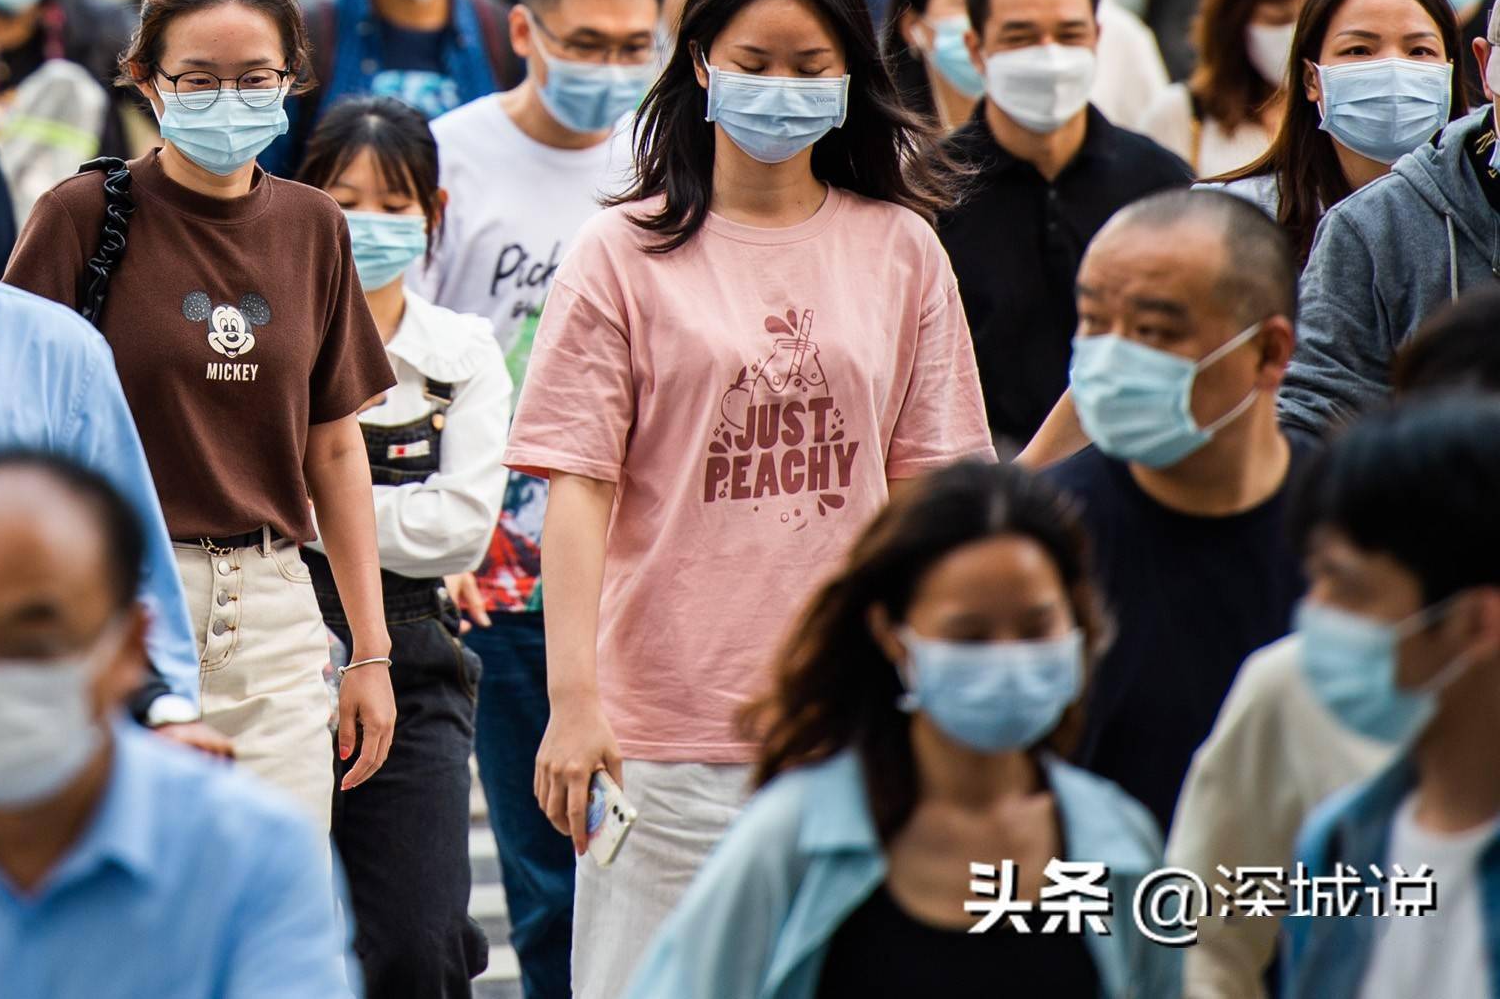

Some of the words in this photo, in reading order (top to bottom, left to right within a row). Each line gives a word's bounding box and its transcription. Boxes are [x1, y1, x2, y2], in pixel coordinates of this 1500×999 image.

[206, 362, 259, 381] MICKEY
[734, 397, 834, 451] JUST
[704, 441, 860, 503] PEACHY
